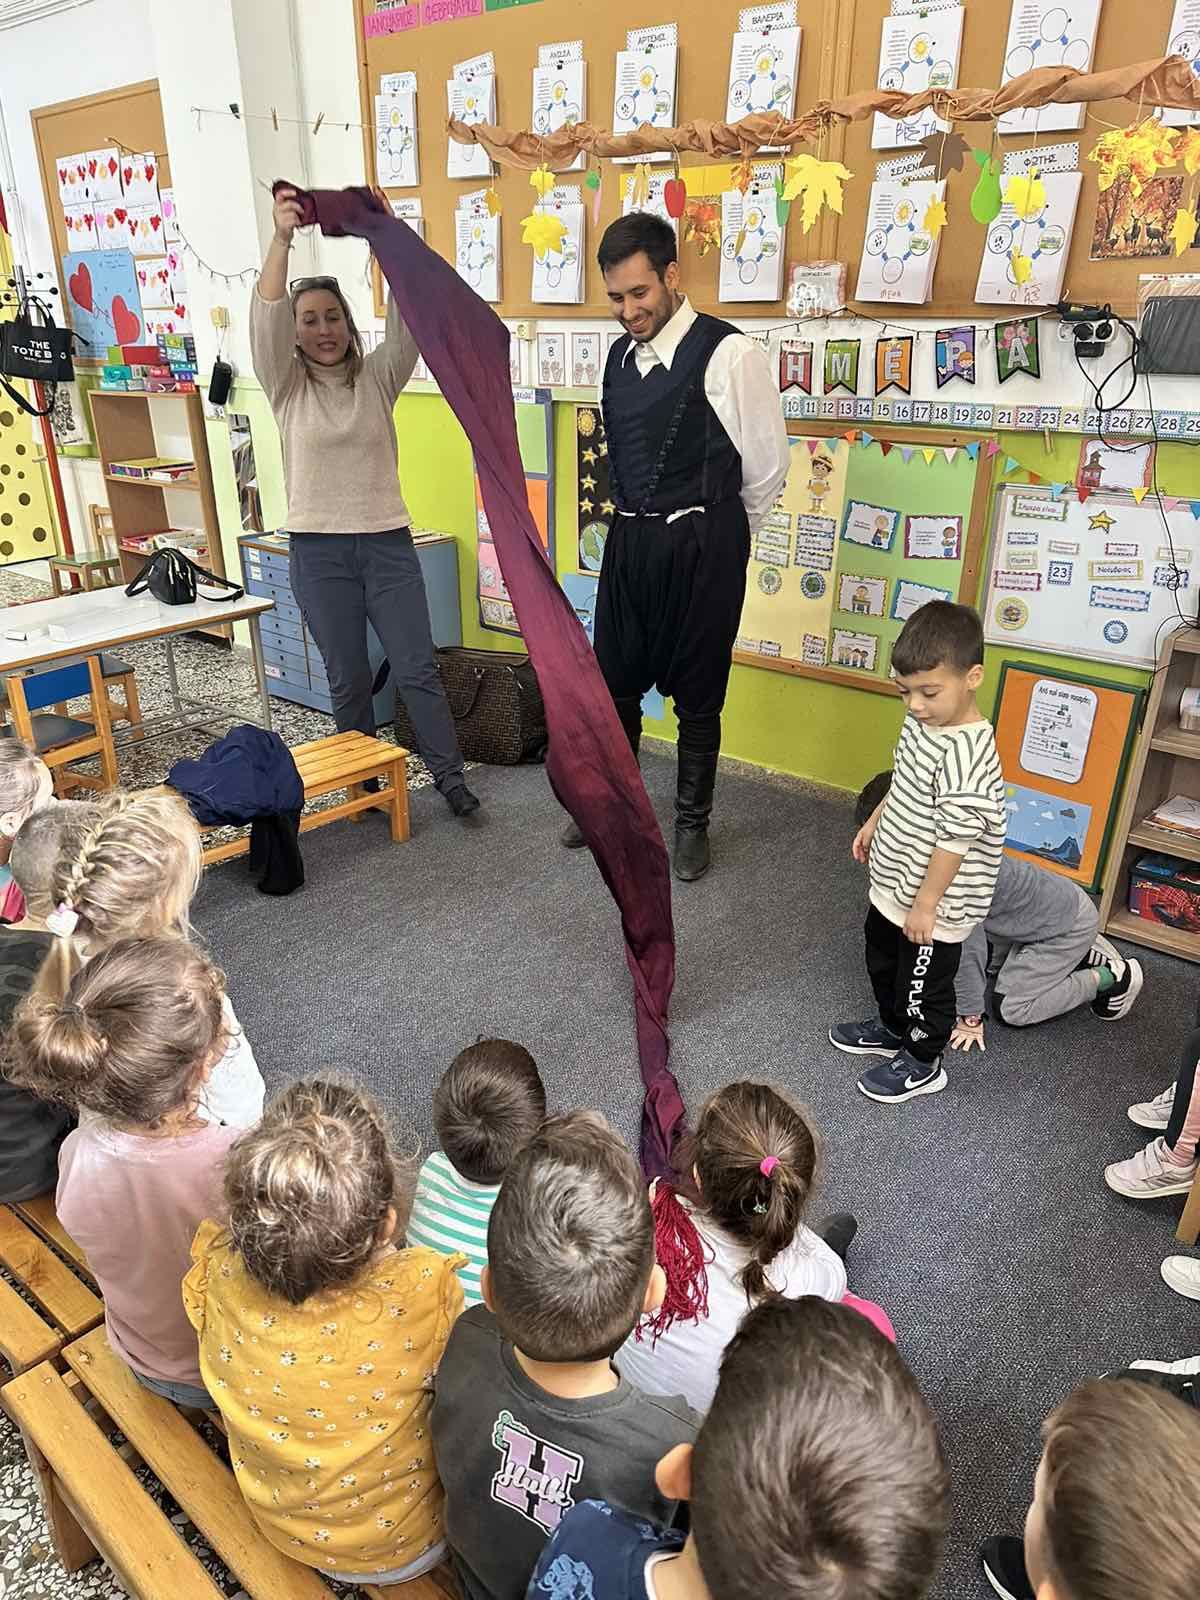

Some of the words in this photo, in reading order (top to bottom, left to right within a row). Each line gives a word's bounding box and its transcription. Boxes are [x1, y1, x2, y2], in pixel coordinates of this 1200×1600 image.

[1023, 153, 1057, 166] ΦΩΤΗΣ
[891, 162, 919, 177] ΣΕΛΕΝ
[11, 345, 42, 358] TOTE
[29, 340, 50, 350] THE
[548, 346, 555, 357] 8
[582, 348, 589, 359] 9
[787, 401, 799, 412] 10
[806, 402, 815, 413] 11
[822, 402, 833, 413] 12
[840, 403, 852, 415] 13
[858, 403, 870, 415] 14
[878, 404, 890, 416] 15
[896, 406, 908, 418] 16
[915, 407, 928, 419] 17
[935, 408, 948, 419] 18
[956, 409, 970, 421] 19
[976, 410, 991, 421] 20
[998, 412, 1011, 424] 21
[1019, 412, 1034, 423] 22
[1041, 413, 1056, 424] 23
[1064, 413, 1079, 425] 24
[1087, 415, 1103, 427] 25
[1112, 416, 1128, 428] 26
[1135, 417, 1152, 429] 27
[1160, 418, 1177, 430] 28
[1052, 567, 1067, 578] 23
[1160, 573, 1181, 582] 202
[913, 945, 934, 976] ECO
[497, 1461, 572, 1507] Hulk
